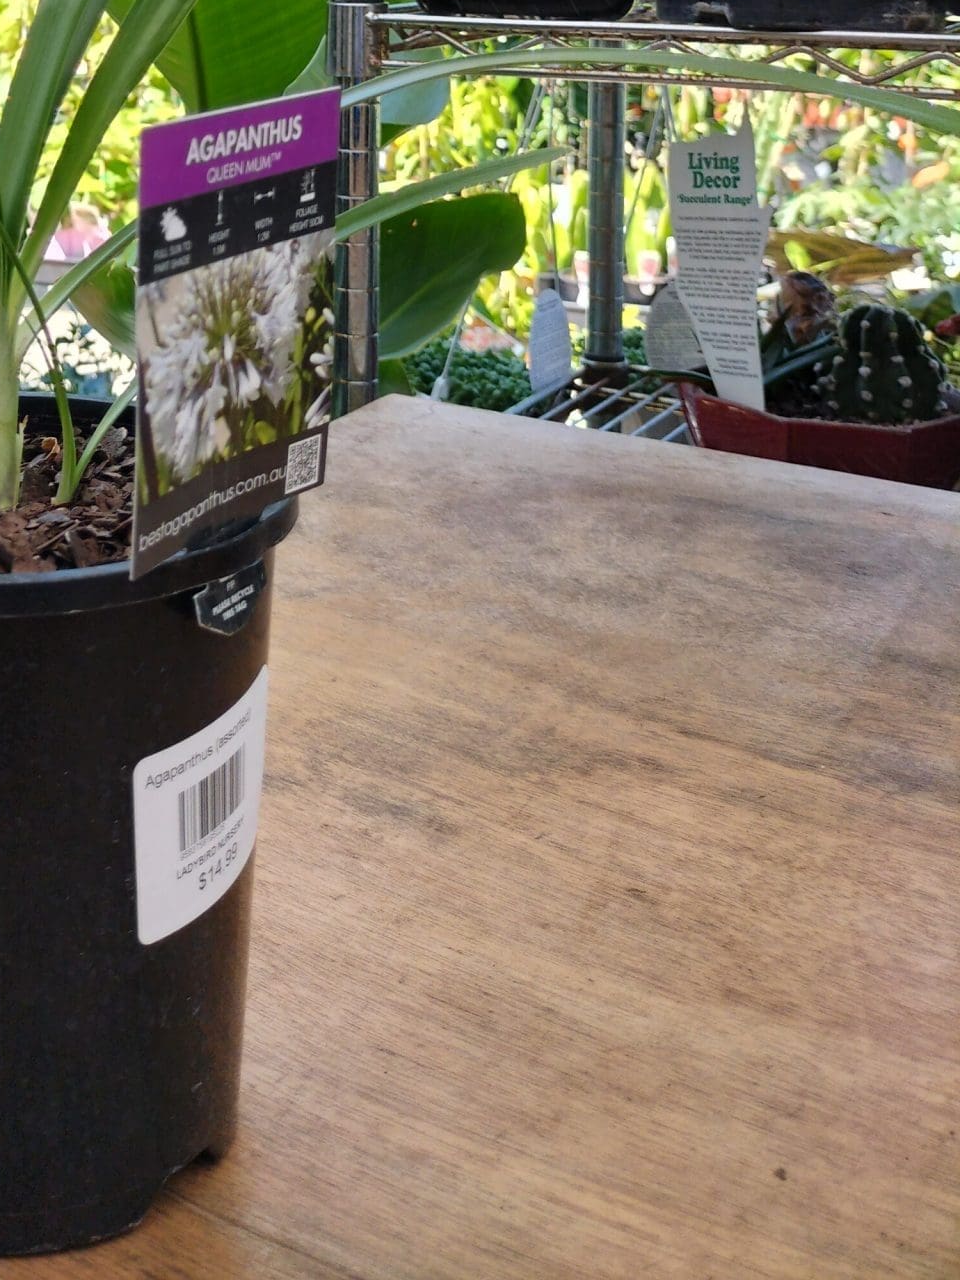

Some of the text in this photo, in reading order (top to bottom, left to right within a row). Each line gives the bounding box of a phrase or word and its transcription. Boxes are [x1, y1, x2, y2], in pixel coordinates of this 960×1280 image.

[185, 114, 303, 166] AGAPANTHUS
[688, 151, 740, 174] Living
[205, 160, 244, 184] QUEEN
[693, 171, 741, 189] Decor
[138, 465, 288, 552] bestagapanthus.com.au
[144, 745, 214, 790] Agapanthus
[198, 840, 238, 891] $14.99
